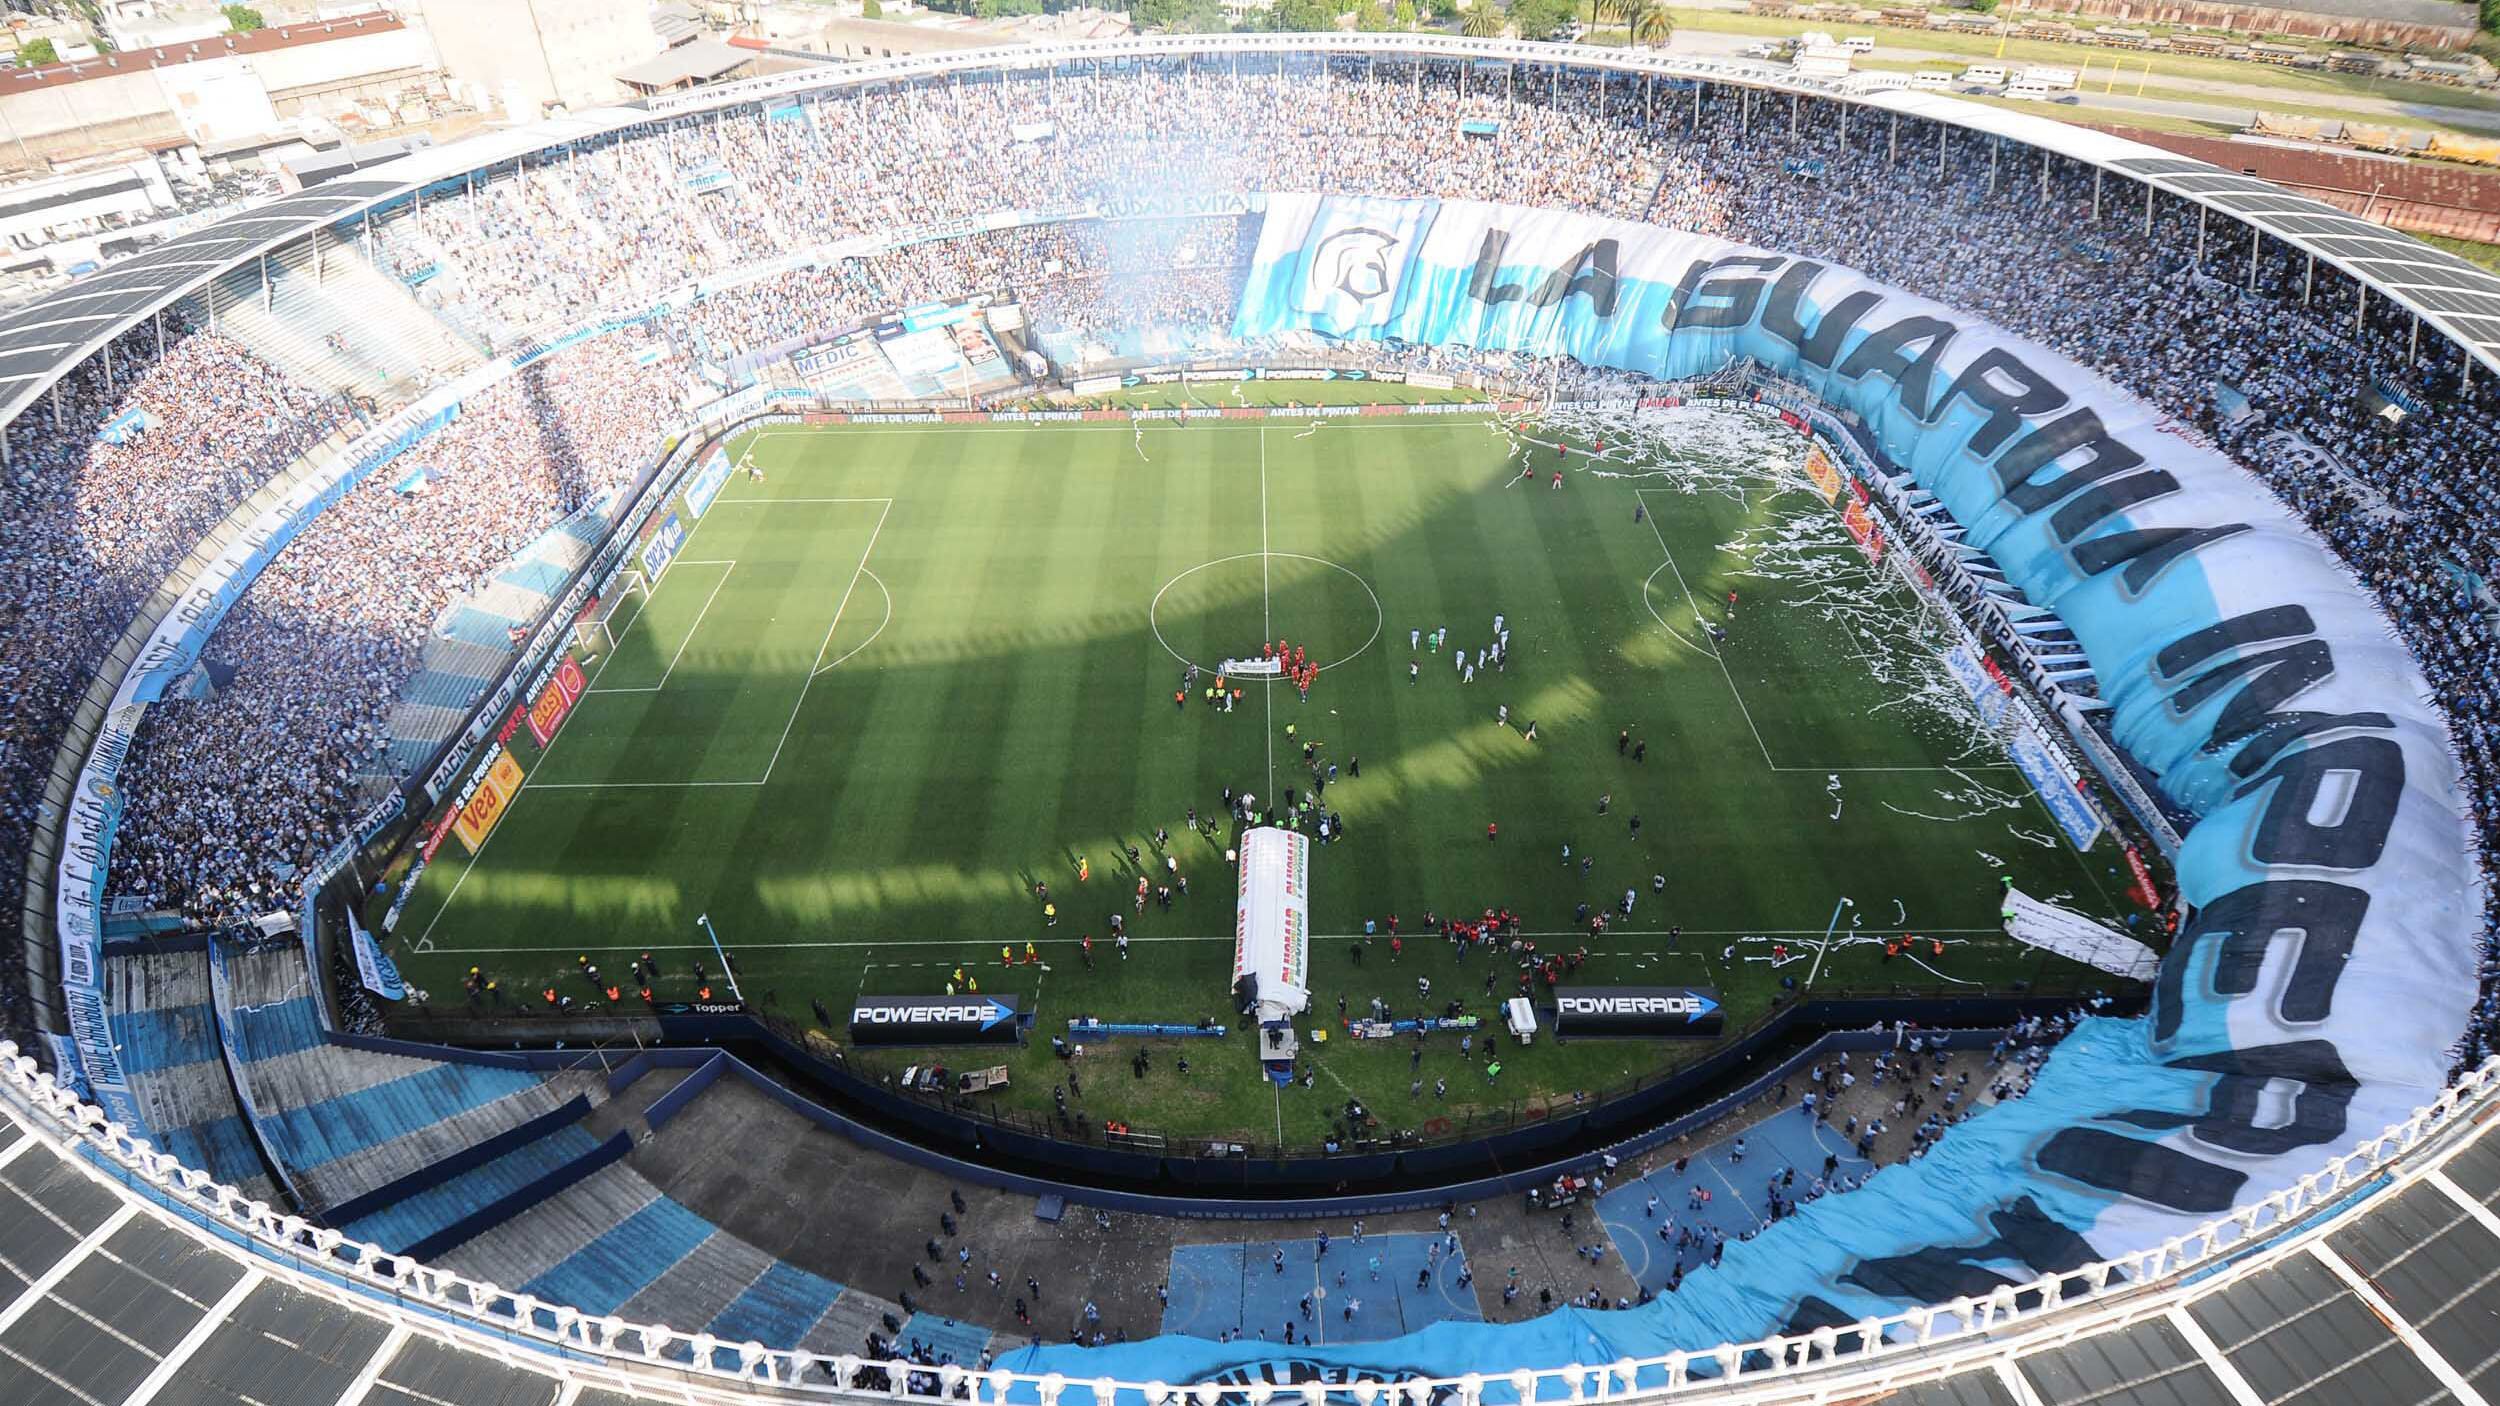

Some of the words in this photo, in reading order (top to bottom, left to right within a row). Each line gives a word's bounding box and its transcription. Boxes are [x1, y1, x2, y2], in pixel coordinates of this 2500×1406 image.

[1094, 197, 1181, 218] CIUDAD
[1184, 194, 1246, 213] EVITA
[797, 343, 859, 375] MEDIC
[1370, 372, 1405, 382] Topper
[1132, 411, 1166, 419] ANTES
[1168, 410, 1182, 419] DE
[1271, 408, 1305, 416] ANTES
[1307, 408, 1320, 416] DE
[1321, 407, 1360, 416] PINTAR
[1409, 404, 1442, 413] ANTES
[1444, 404, 1460, 412] DE
[1462, 403, 1498, 412] PINTAR
[1469, 226, 1620, 319] LA
[1661, 252, 2254, 598] GUARDIA
[1549, 402, 1580, 410] ANTES
[1582, 402, 1596, 410] DE
[1599, 401, 1634, 410] PINTAR
[1686, 398, 1720, 407] ANTES
[1722, 399, 1736, 408] DE
[1739, 401, 1781, 417] PINTAR
[852, 414, 886, 423] ANTES
[888, 414, 904, 423] DE
[906, 413, 942, 422] PINTAR
[993, 412, 1026, 421] ANTES
[1028, 412, 1045, 421] DE
[1047, 411, 1082, 420] PINTAR
[477, 686, 512, 728] CLUB
[510, 660, 532, 686] DE
[589, 538, 622, 583] PRIMER
[524, 667, 547, 705] ANTES
[543, 655, 556, 673] DE
[460, 778, 476, 799] DE
[471, 741, 502, 784] PINTAR
[460, 783, 499, 830] Vea
[695, 1003, 741, 1014] Topper
[1557, 998, 1701, 1013] POWERADE
[853, 1006, 997, 1024] POWERADE
[81, 1045, 122, 1084] PARQUE
